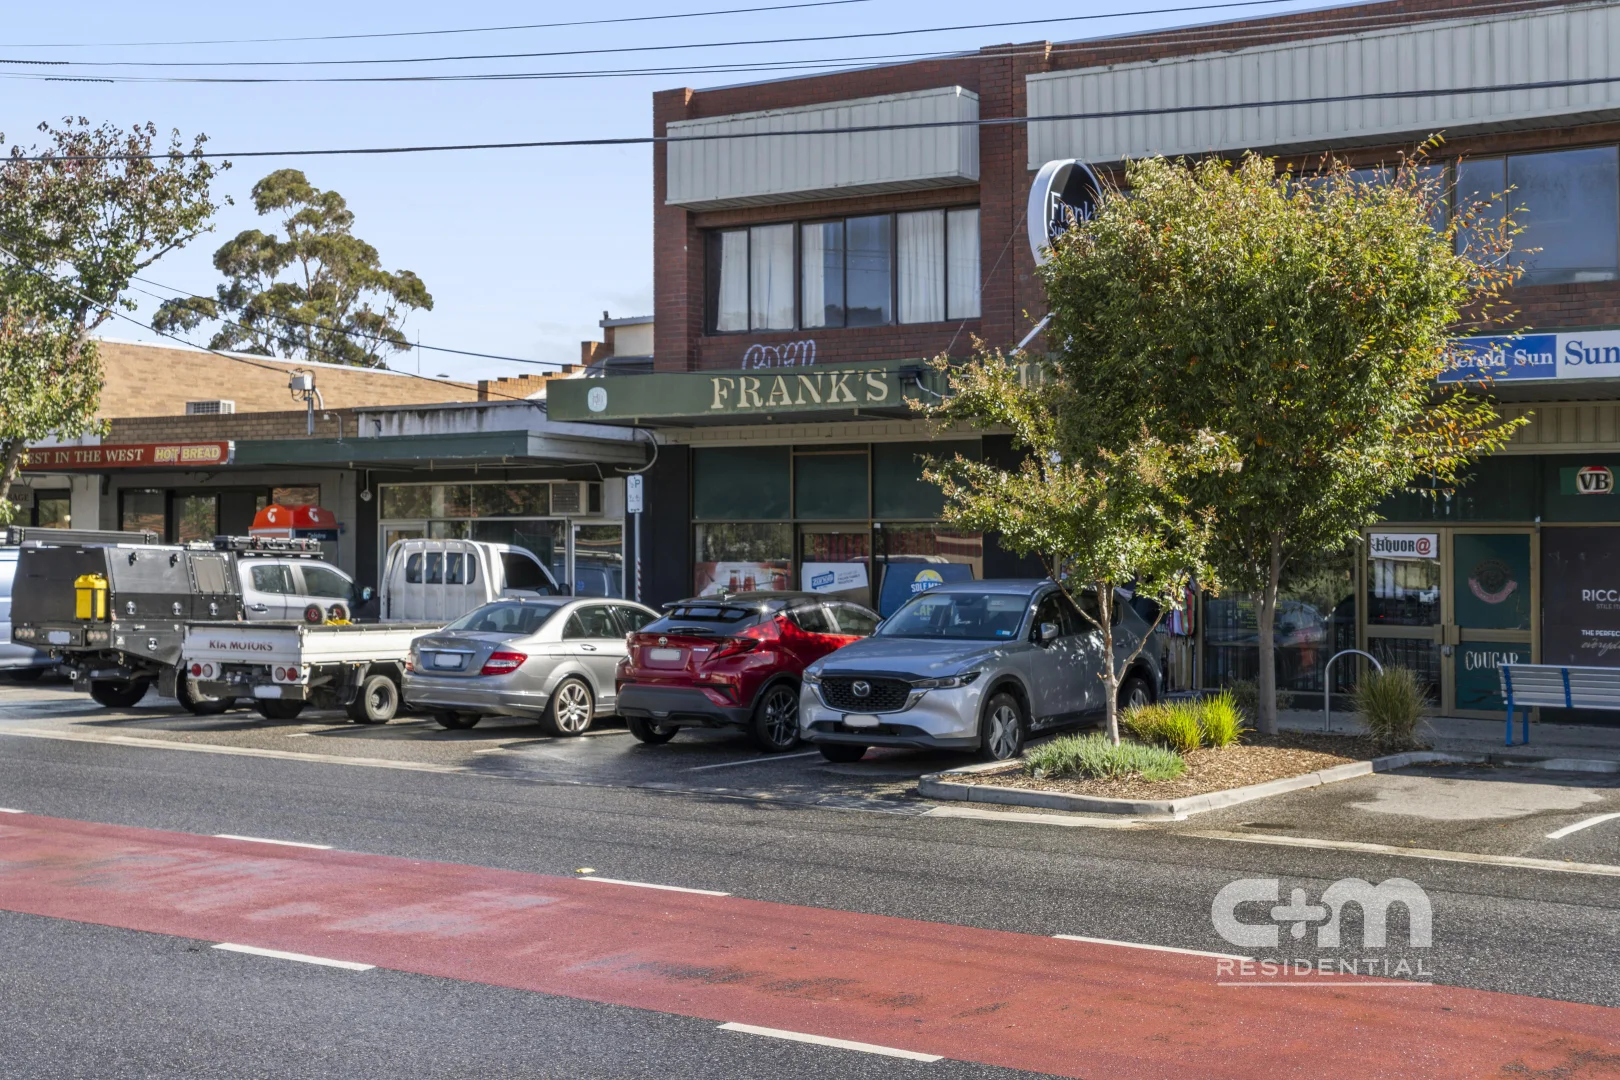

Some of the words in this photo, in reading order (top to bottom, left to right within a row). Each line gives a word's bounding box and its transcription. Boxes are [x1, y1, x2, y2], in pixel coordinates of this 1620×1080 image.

[1514, 349, 1554, 366] Sun
[1565, 340, 1620, 365] Sun
[710, 367, 889, 410] FRANK'S
[20, 452, 50, 465] EST
[55, 452, 69, 463] IN
[74, 450, 101, 463] THE
[105, 448, 144, 462] WEST
[154, 447, 180, 461] HOT
[181, 446, 220, 460] BREAD
[1579, 473, 1609, 490] VB
[1582, 589, 1620, 601] RICC
[209, 640, 227, 649] KIA
[229, 641, 273, 651] MOTORS
